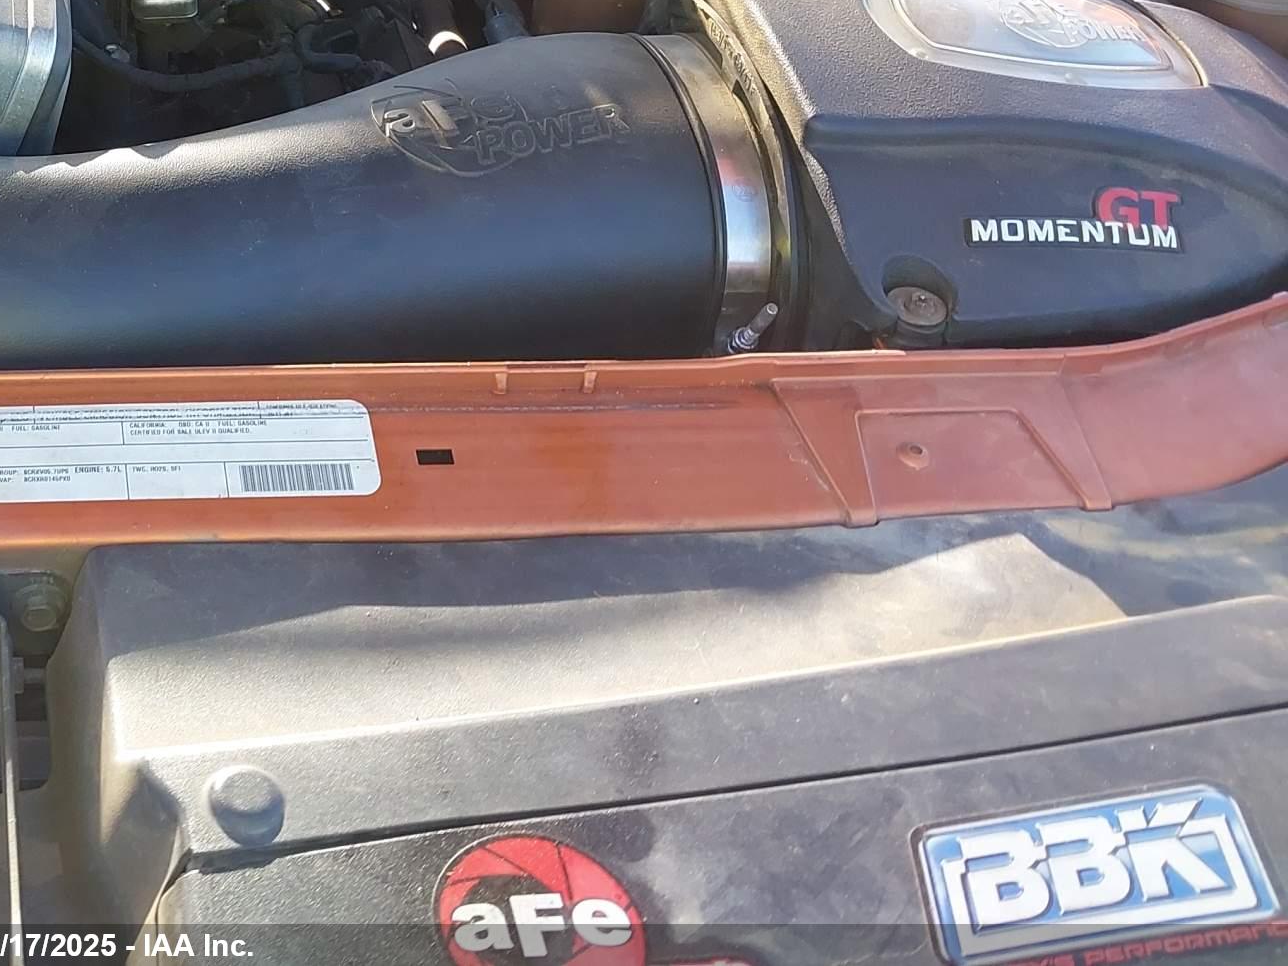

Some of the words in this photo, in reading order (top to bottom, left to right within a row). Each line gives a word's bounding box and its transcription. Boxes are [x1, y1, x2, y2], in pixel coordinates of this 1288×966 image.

[970, 218, 1178, 249] MOMENTUM
[1095, 187, 1180, 229] GT
[965, 799, 1225, 928] BBK
[450, 892, 632, 958] aFe
